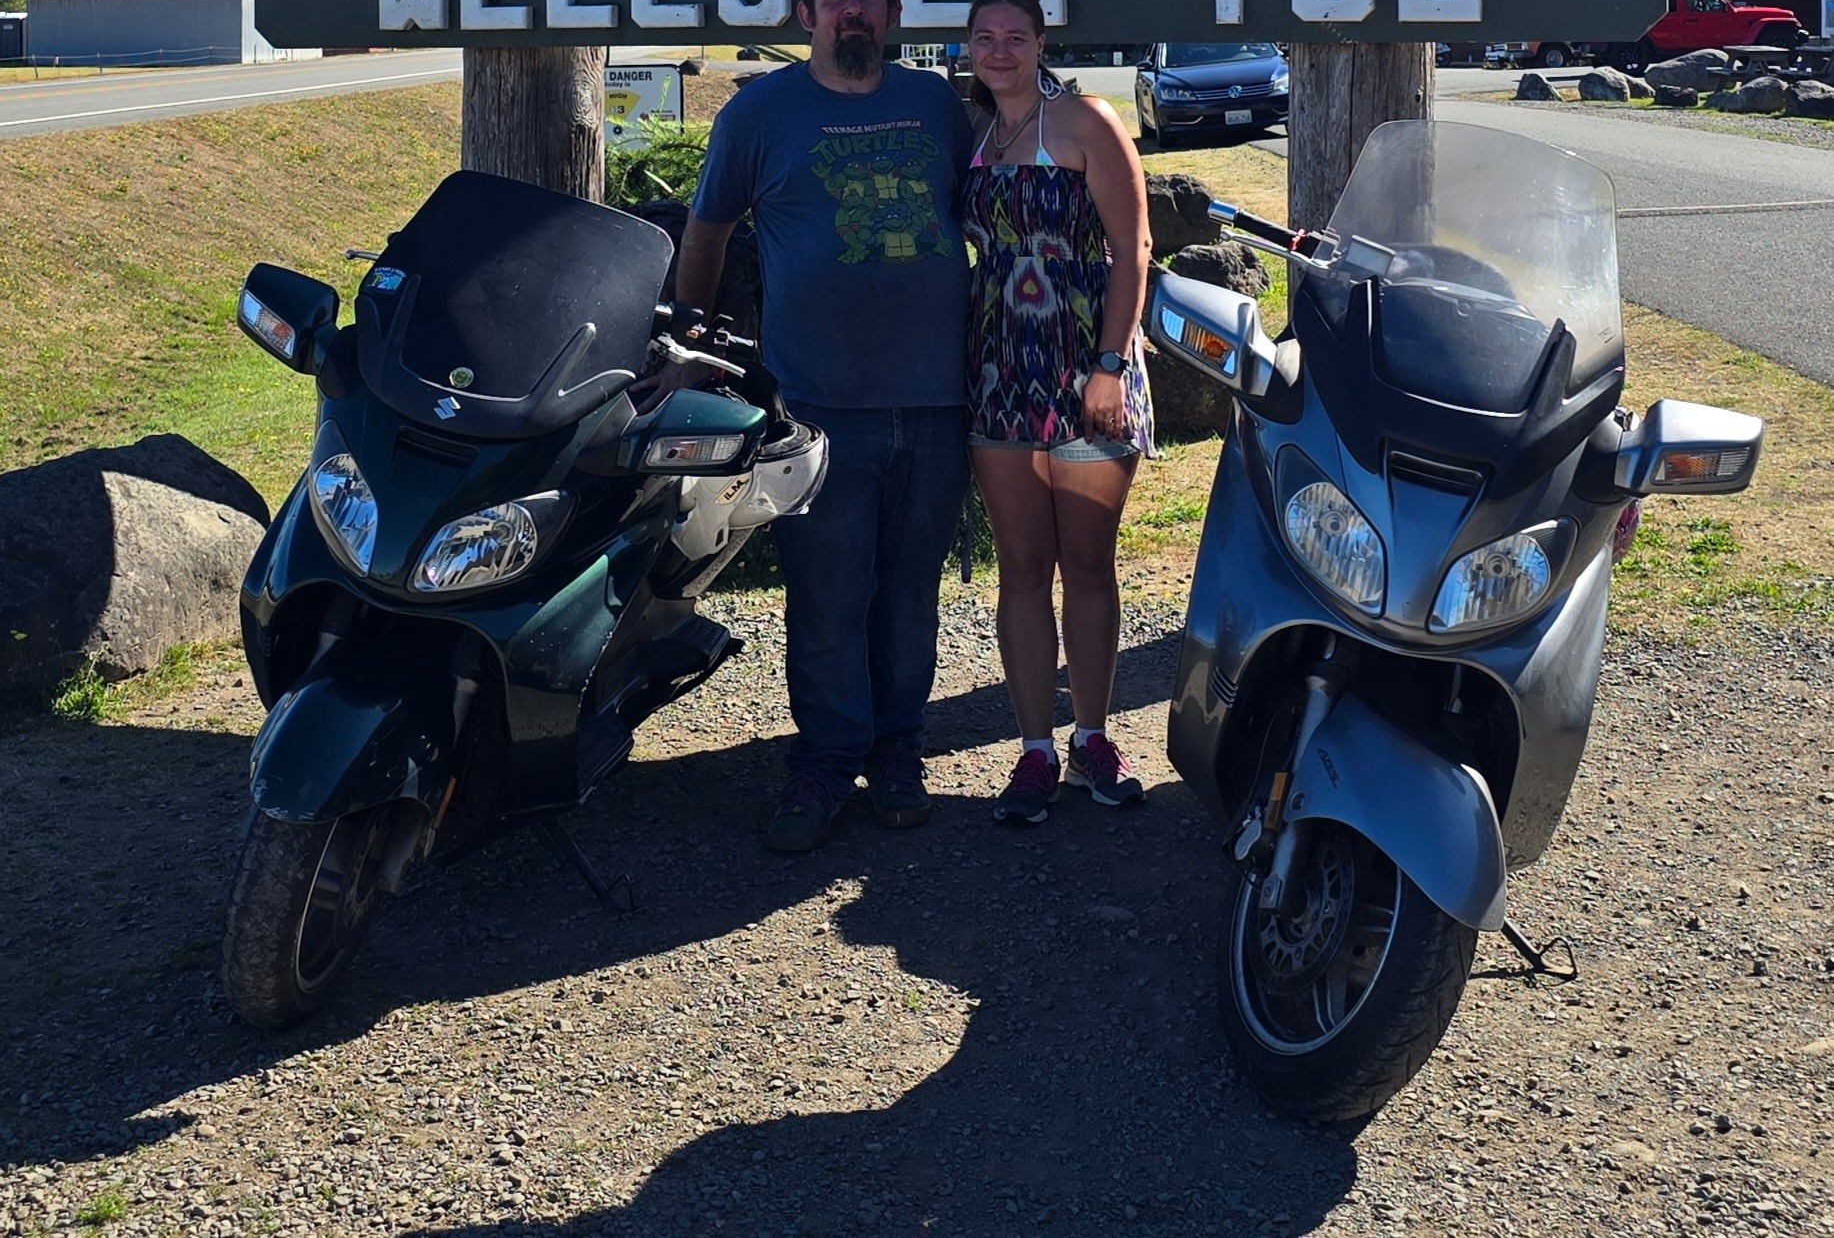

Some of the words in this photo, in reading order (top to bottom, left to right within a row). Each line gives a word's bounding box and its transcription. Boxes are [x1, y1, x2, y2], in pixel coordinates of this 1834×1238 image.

[609, 71, 652, 81] DANGER
[821, 125, 864, 135] TEENAGE
[864, 121, 896, 133] MUTANT
[896, 120, 922, 129] NINJA
[807, 130, 941, 165] TURTLES
